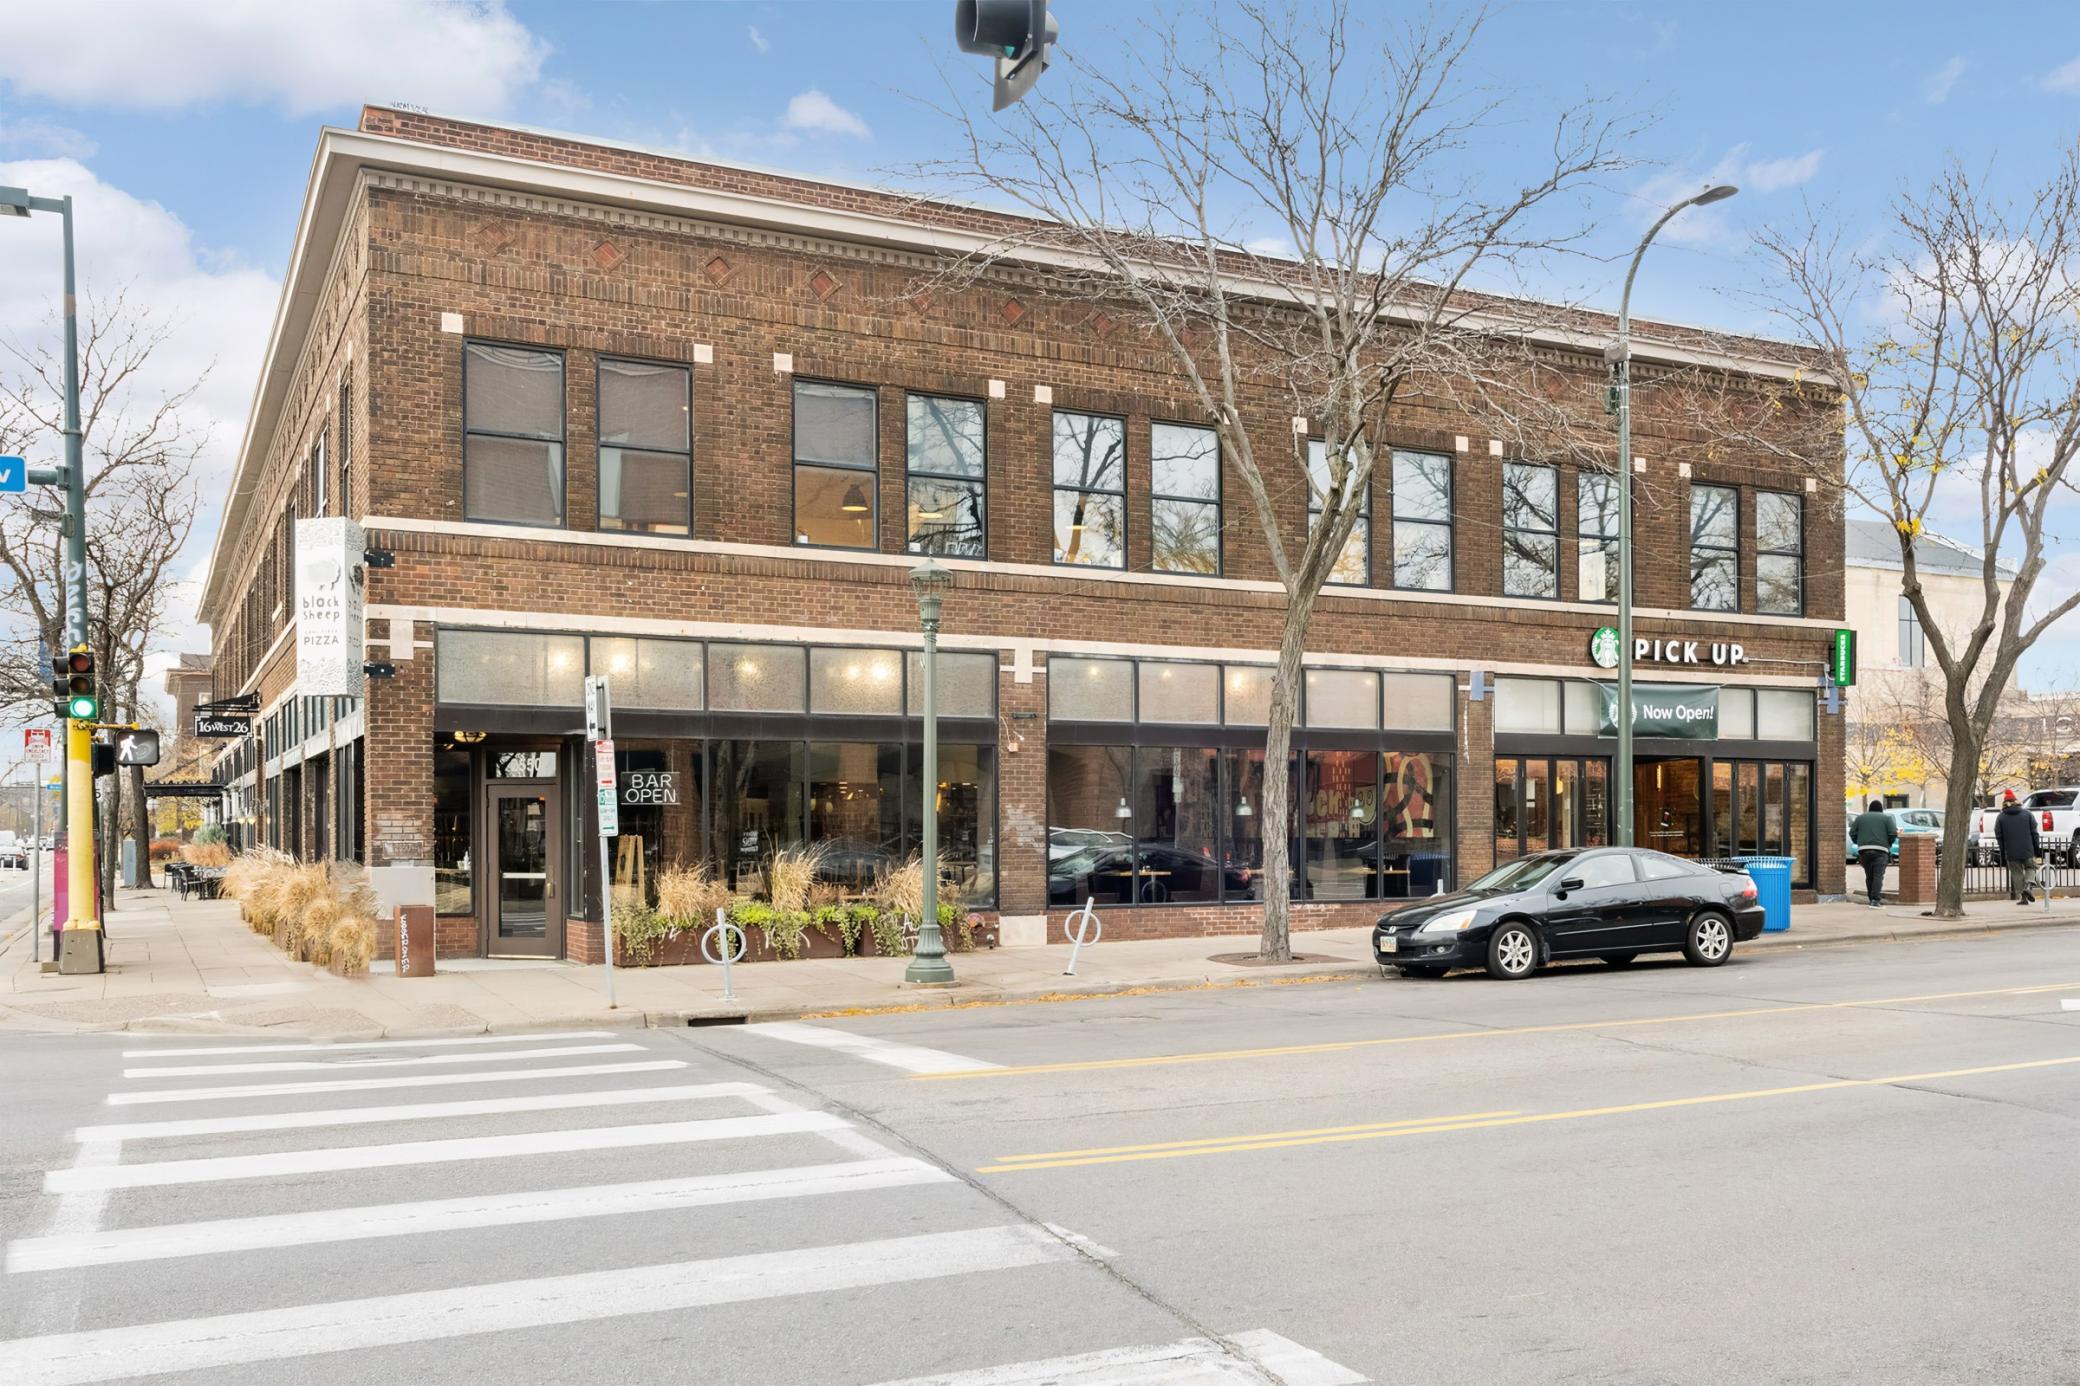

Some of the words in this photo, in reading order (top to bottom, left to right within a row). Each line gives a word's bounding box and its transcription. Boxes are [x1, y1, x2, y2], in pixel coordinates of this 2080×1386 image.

[303, 595, 340, 609] black
[303, 636, 340, 646] PIZZA
[1634, 638, 1699, 664] PICK
[1712, 643, 1744, 665] UP
[1643, 704, 1673, 720] Now
[1675, 704, 1715, 723] Open!
[631, 773, 672, 789] BAR
[625, 788, 676, 803] OPEN
